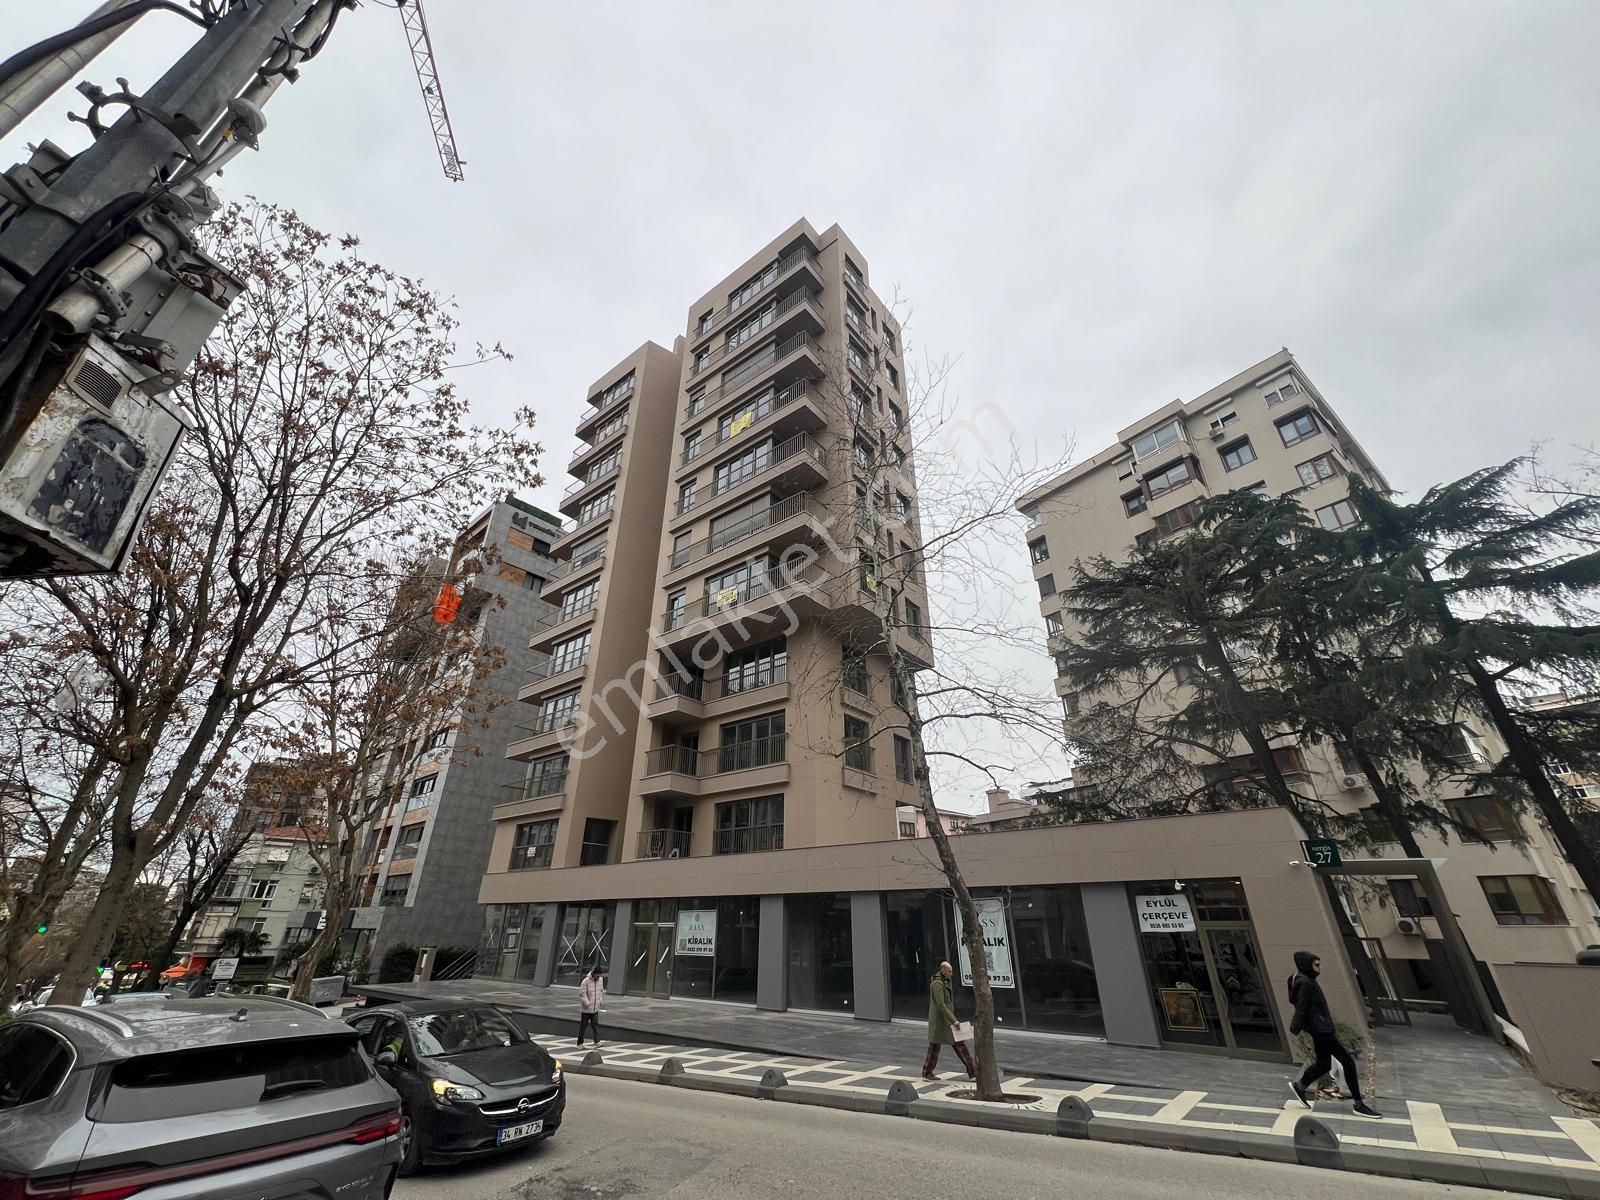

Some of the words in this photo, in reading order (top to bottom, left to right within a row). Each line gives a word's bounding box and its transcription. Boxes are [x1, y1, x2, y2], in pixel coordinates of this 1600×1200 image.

[1315, 852, 1332, 863] 27
[1146, 898, 1178, 907] EYLÜL
[1142, 912, 1188, 921] ÇERÇEVE
[687, 935, 713, 945] KİRALIK
[961, 937, 1006, 947] KALIK
[502, 1129, 511, 1140] 34
